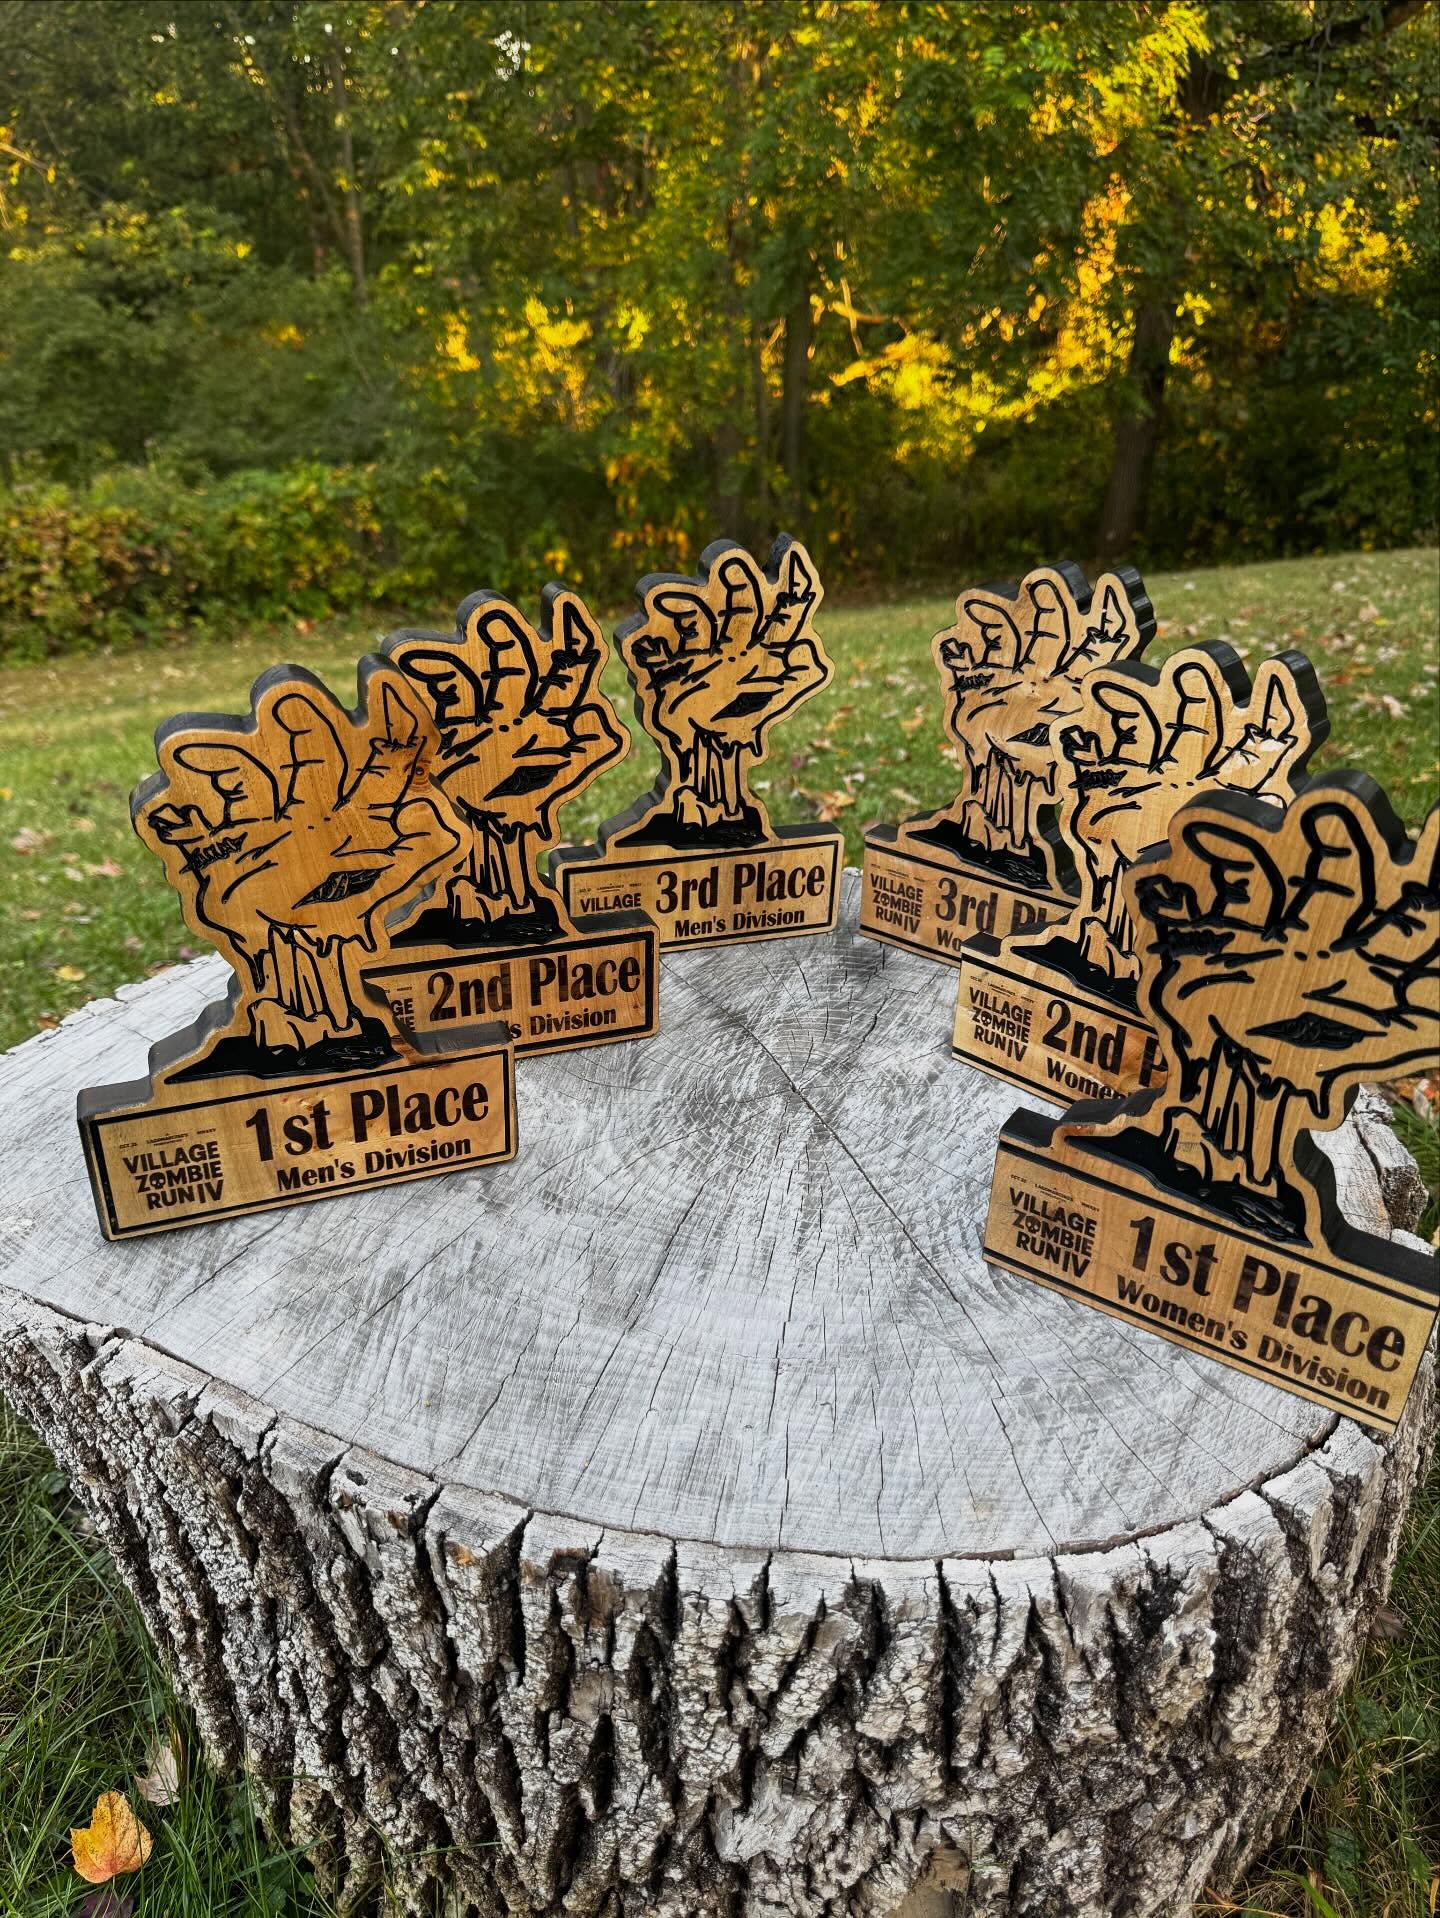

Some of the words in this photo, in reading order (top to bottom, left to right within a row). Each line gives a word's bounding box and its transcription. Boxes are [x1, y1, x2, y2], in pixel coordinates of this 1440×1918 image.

[580, 892, 642, 913] VILLAGE
[656, 866, 719, 914] 3rd
[733, 861, 825, 905] Place
[870, 873, 924, 903] VILLAGE
[935, 877, 998, 935] 3rd
[674, 914, 726, 938] Men's
[733, 907, 805, 931] Division
[427, 962, 513, 1022] 2nd
[528, 954, 641, 1007] Place
[969, 986, 1033, 1027] VILLAGE
[530, 1006, 617, 1037] Division
[1042, 999, 1127, 1076] 2nd
[245, 1098, 335, 1163] 1st
[349, 1082, 490, 1144] Place
[122, 1140, 220, 1174] VILLAGE
[276, 1158, 357, 1192] Men's
[364, 1137, 471, 1174] Division
[1009, 1186, 1097, 1239] VILLAGE
[1129, 1214, 1219, 1298] 1st
[1232, 1254, 1406, 1374] Place
[1116, 1273, 1248, 1351] Women's
[1256, 1333, 1391, 1411] Division
